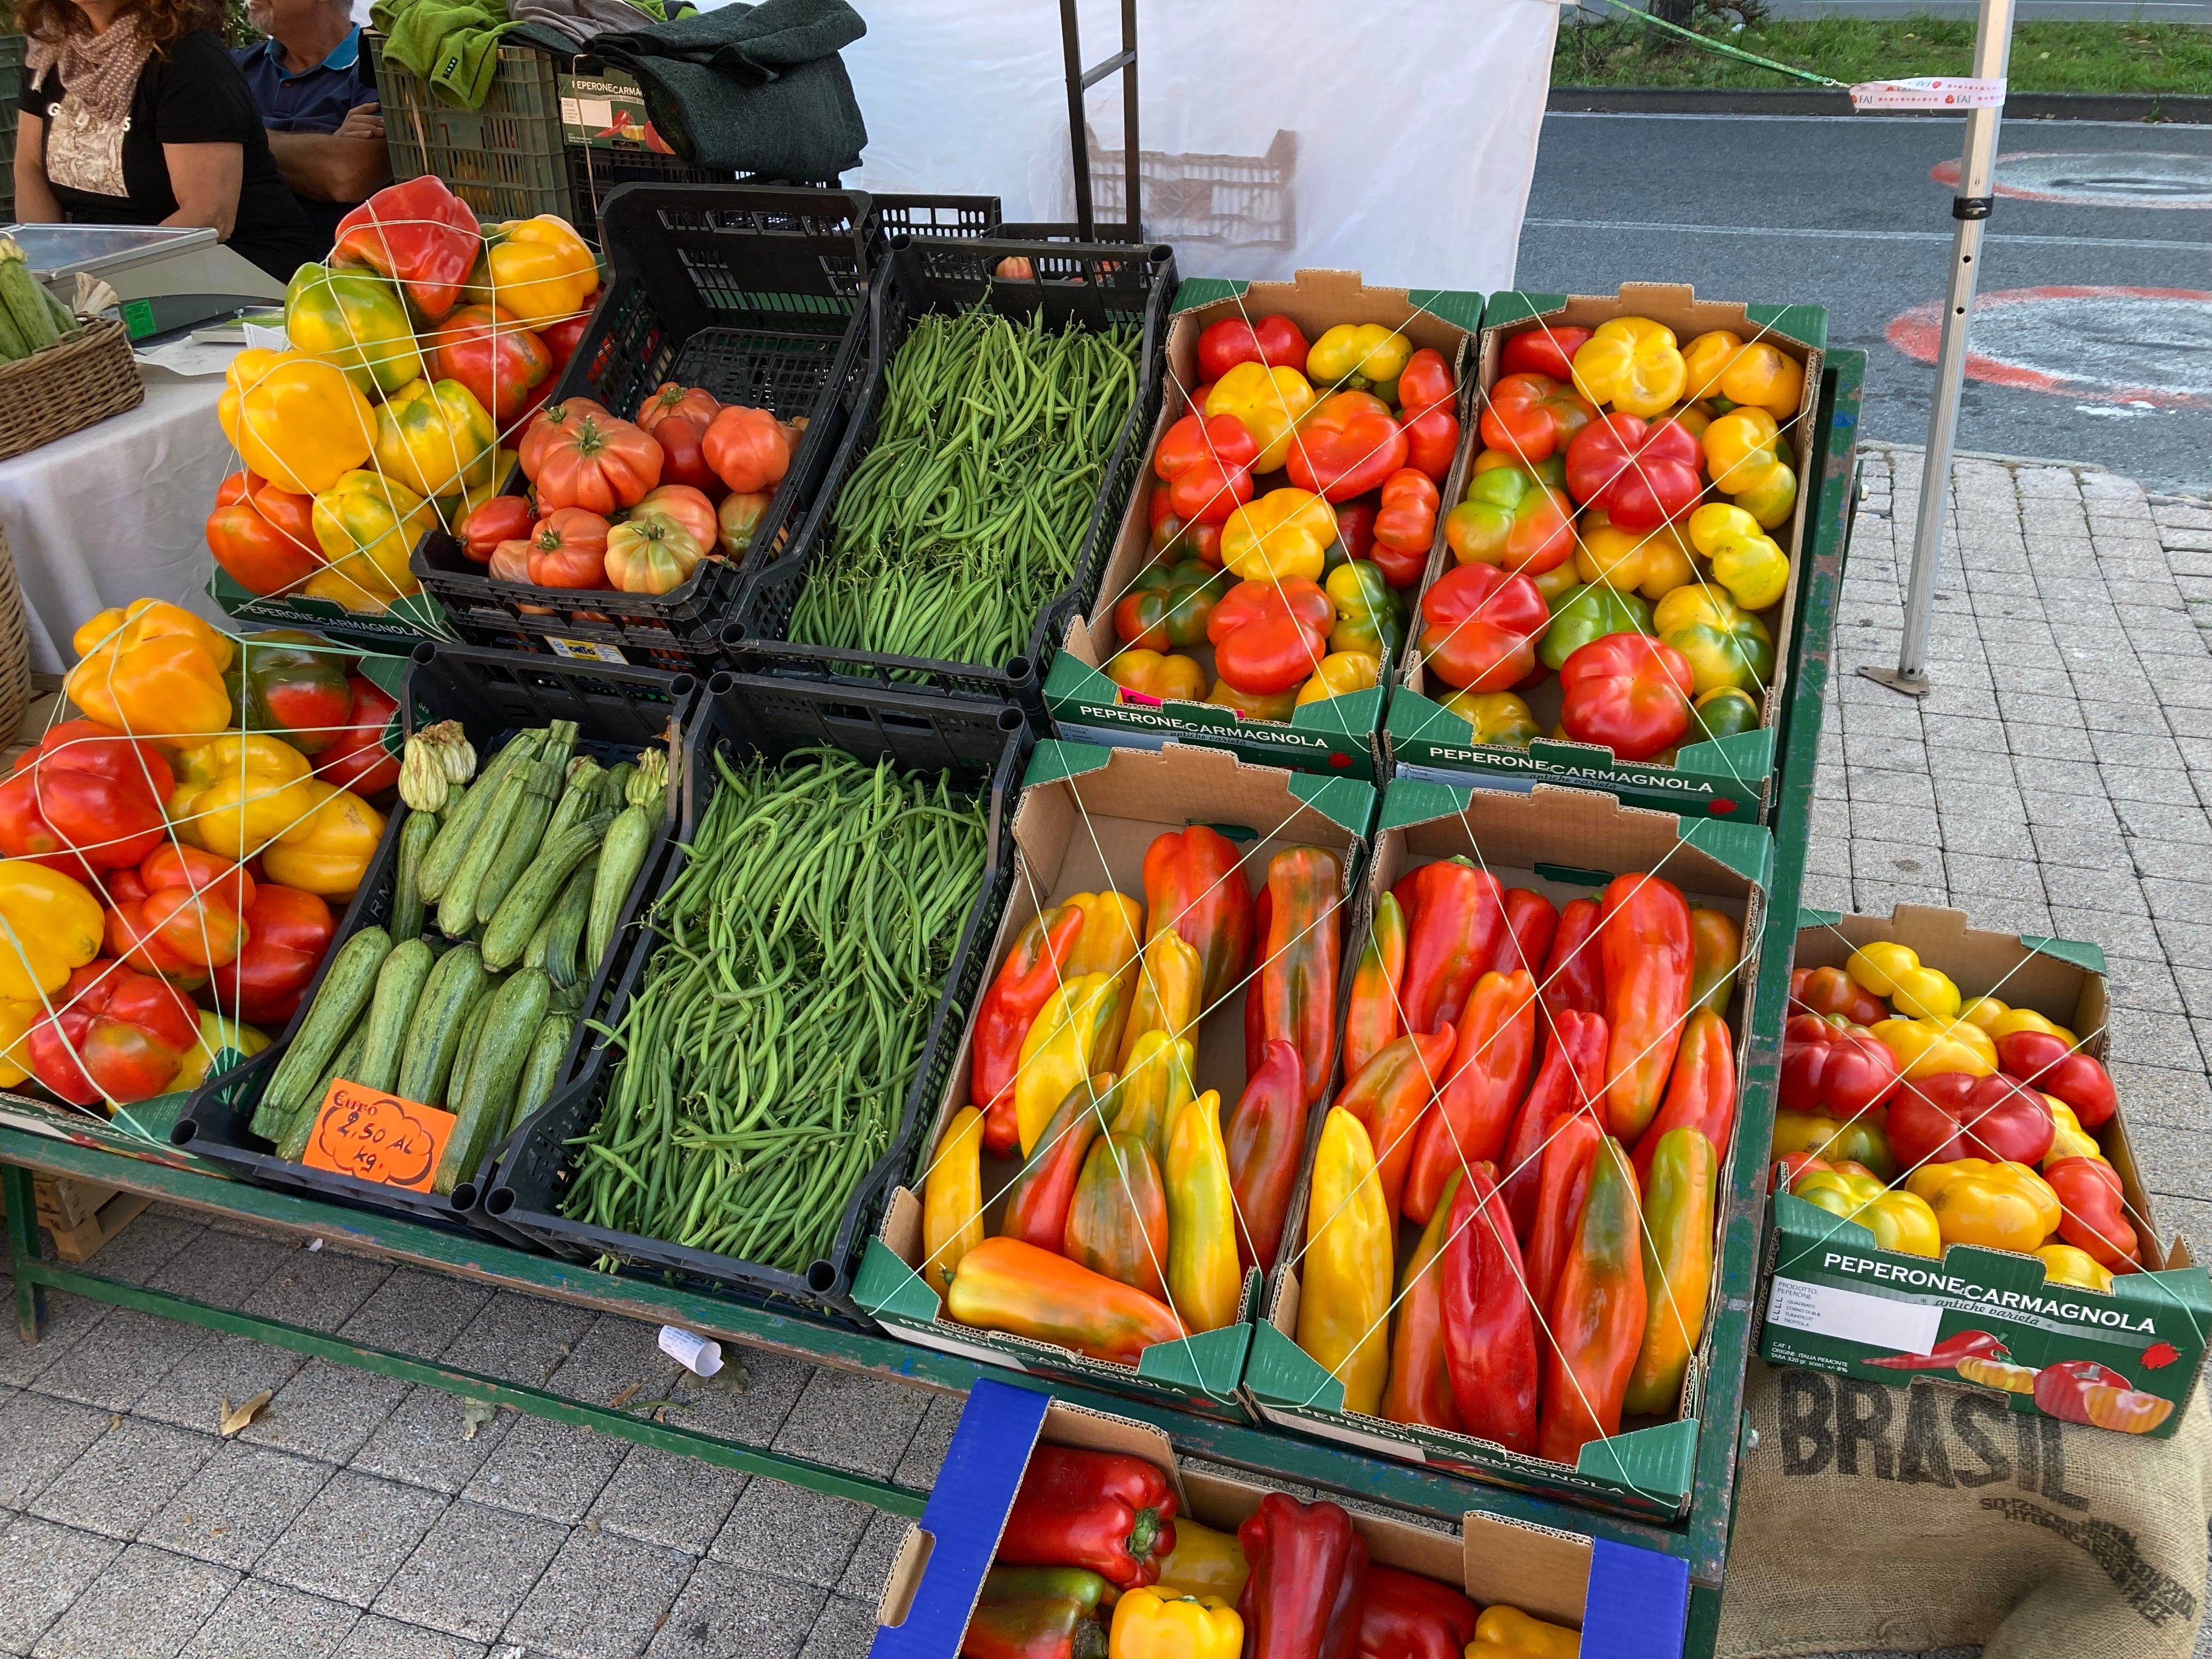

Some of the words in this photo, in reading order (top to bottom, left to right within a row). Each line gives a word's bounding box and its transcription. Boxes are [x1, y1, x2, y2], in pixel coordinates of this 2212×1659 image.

[1859, 95, 1872, 104] FAI
[1956, 94, 1971, 104] FAI
[318, 617, 425, 637] CARMAGNOLA
[1079, 706, 1183, 729] PEPERONE
[1185, 723, 1329, 748] CARMAGNOLA
[1429, 746, 1549, 770] PEPERONE
[1549, 764, 1714, 793] CARMAGNOLA
[1528, 773, 1571, 784] antiche
[1777, 1288, 1812, 1300] PEPERONE
[1823, 1252, 1966, 1292] PEPERONE
[1966, 1284, 2156, 1334] CARMAGNOLA
[1936, 1297, 1985, 1313] antiche
[1987, 1306, 2040, 1326] varietà
[899, 1317, 1016, 1353] PEPERONE
[1771, 1352, 1786, 1361] TARA
[1787, 1355, 1799, 1363] 320
[1798, 1352, 1816, 1361] ITALIA
[1816, 1356, 1848, 1367] PIEMONTE
[1297, 1407, 1435, 1447] PEPERONE
[1432, 1444, 1626, 1495] CARMAGNOLA
[1777, 1369, 2090, 1511] BRASIL
